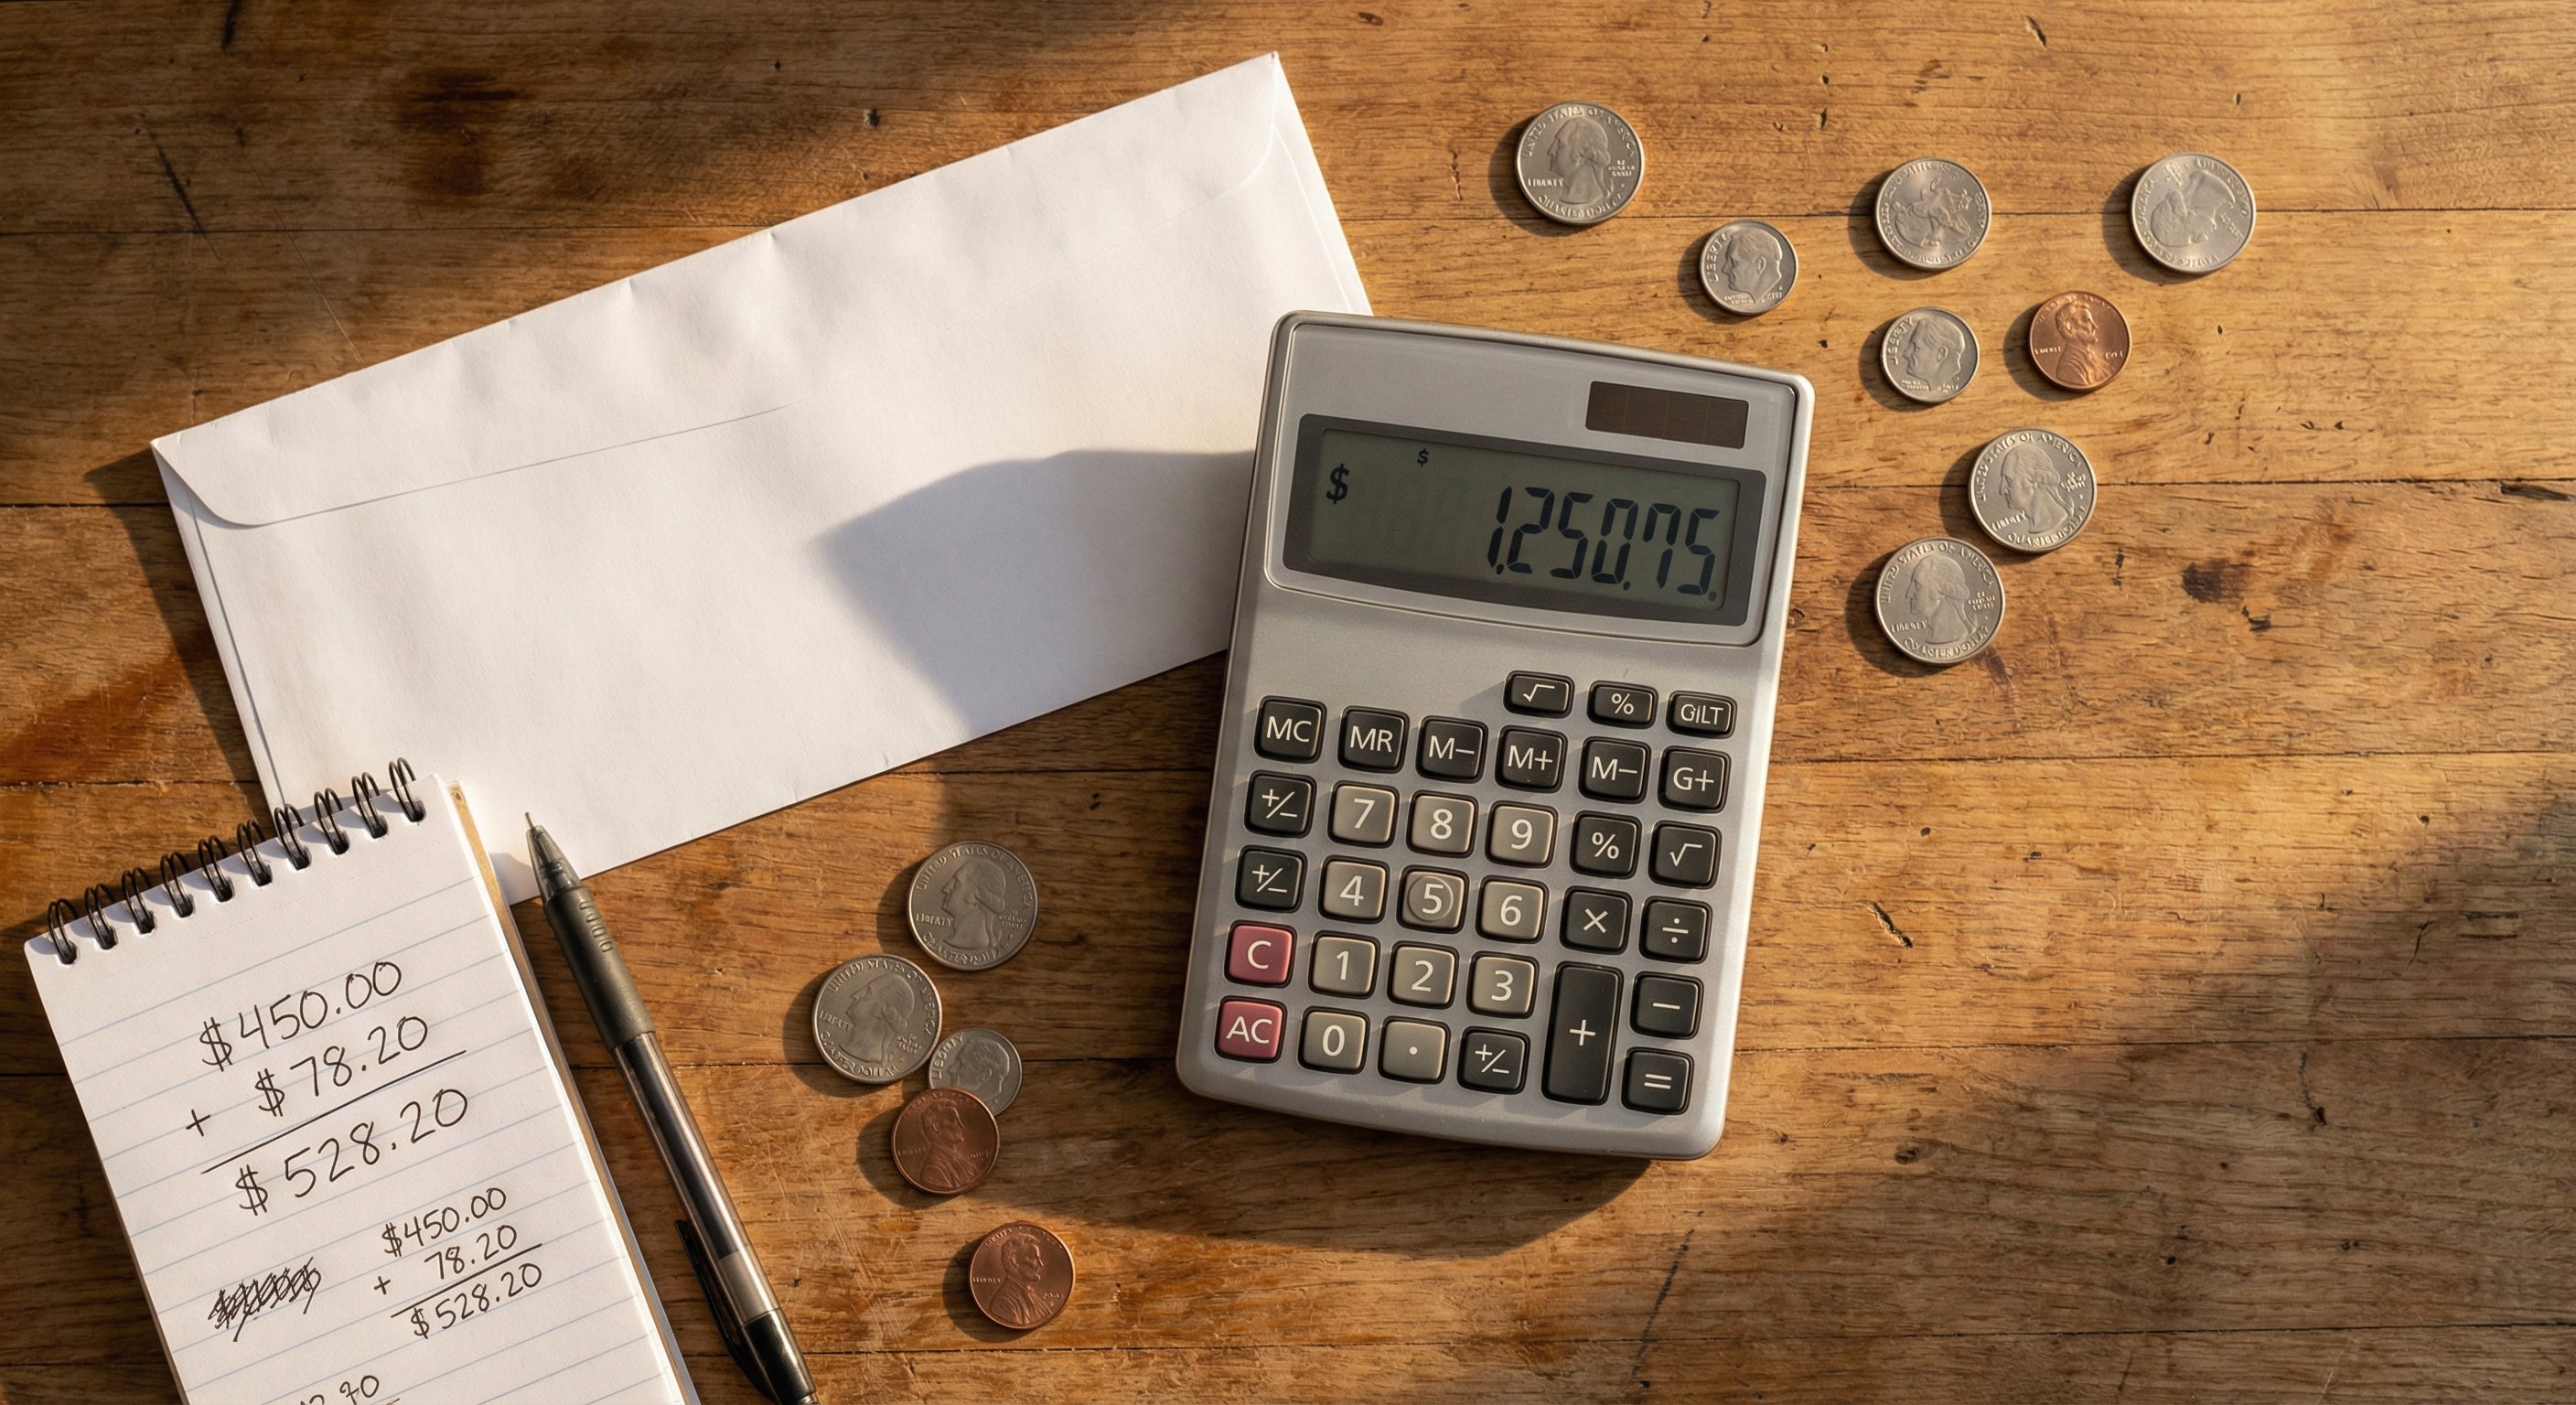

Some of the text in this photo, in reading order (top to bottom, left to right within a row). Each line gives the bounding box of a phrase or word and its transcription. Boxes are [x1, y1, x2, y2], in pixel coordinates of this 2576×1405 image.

[1266, 715, 1312, 743] MC
[1349, 725, 1393, 753] MR
[1508, 745, 1553, 771] M+
[1672, 767, 1714, 791] G+
[1353, 798, 1375, 829] 7
[1430, 809, 1454, 840] 8
[1510, 819, 1533, 850] 9
[1339, 875, 1364, 906] 4
[1422, 883, 1444, 914] 5
[1500, 895, 1522, 926] 6
[1247, 940, 1272, 970] C
[1336, 950, 1349, 981] 1
[1411, 960, 1433, 992] 2
[1491, 970, 1514, 1002] 3
[199, 961, 402, 1072] $450.00
[1226, 1015, 1272, 1045] AC
[1322, 1024, 1346, 1056] 0
[381, 1187, 506, 1258] $450.00
[424, 1225, 517, 1280] 78.20
[411, 1263, 542, 1339] $528.20
